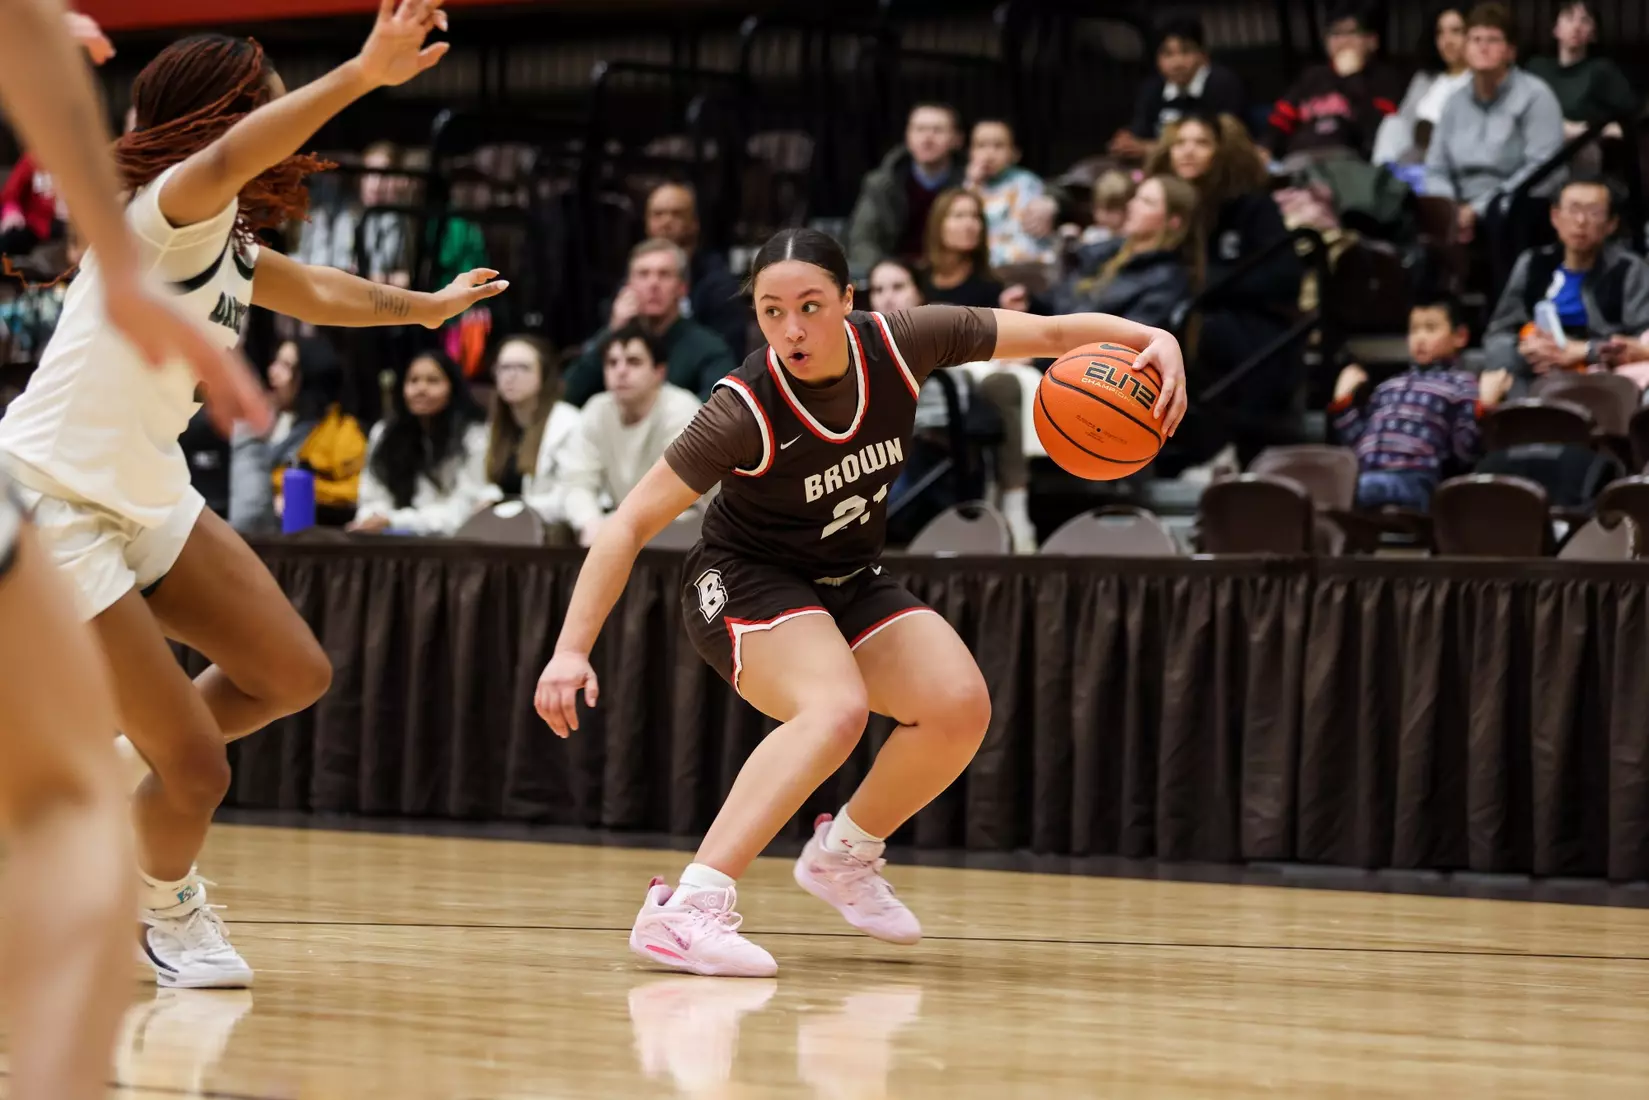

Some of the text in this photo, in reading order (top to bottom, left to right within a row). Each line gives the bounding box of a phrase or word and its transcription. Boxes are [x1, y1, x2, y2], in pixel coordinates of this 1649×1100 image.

[1081, 377, 1141, 409] CHAMPION
[1084, 360, 1157, 411] ELITE
[804, 437, 904, 503] BROWN
[694, 568, 729, 624] B
